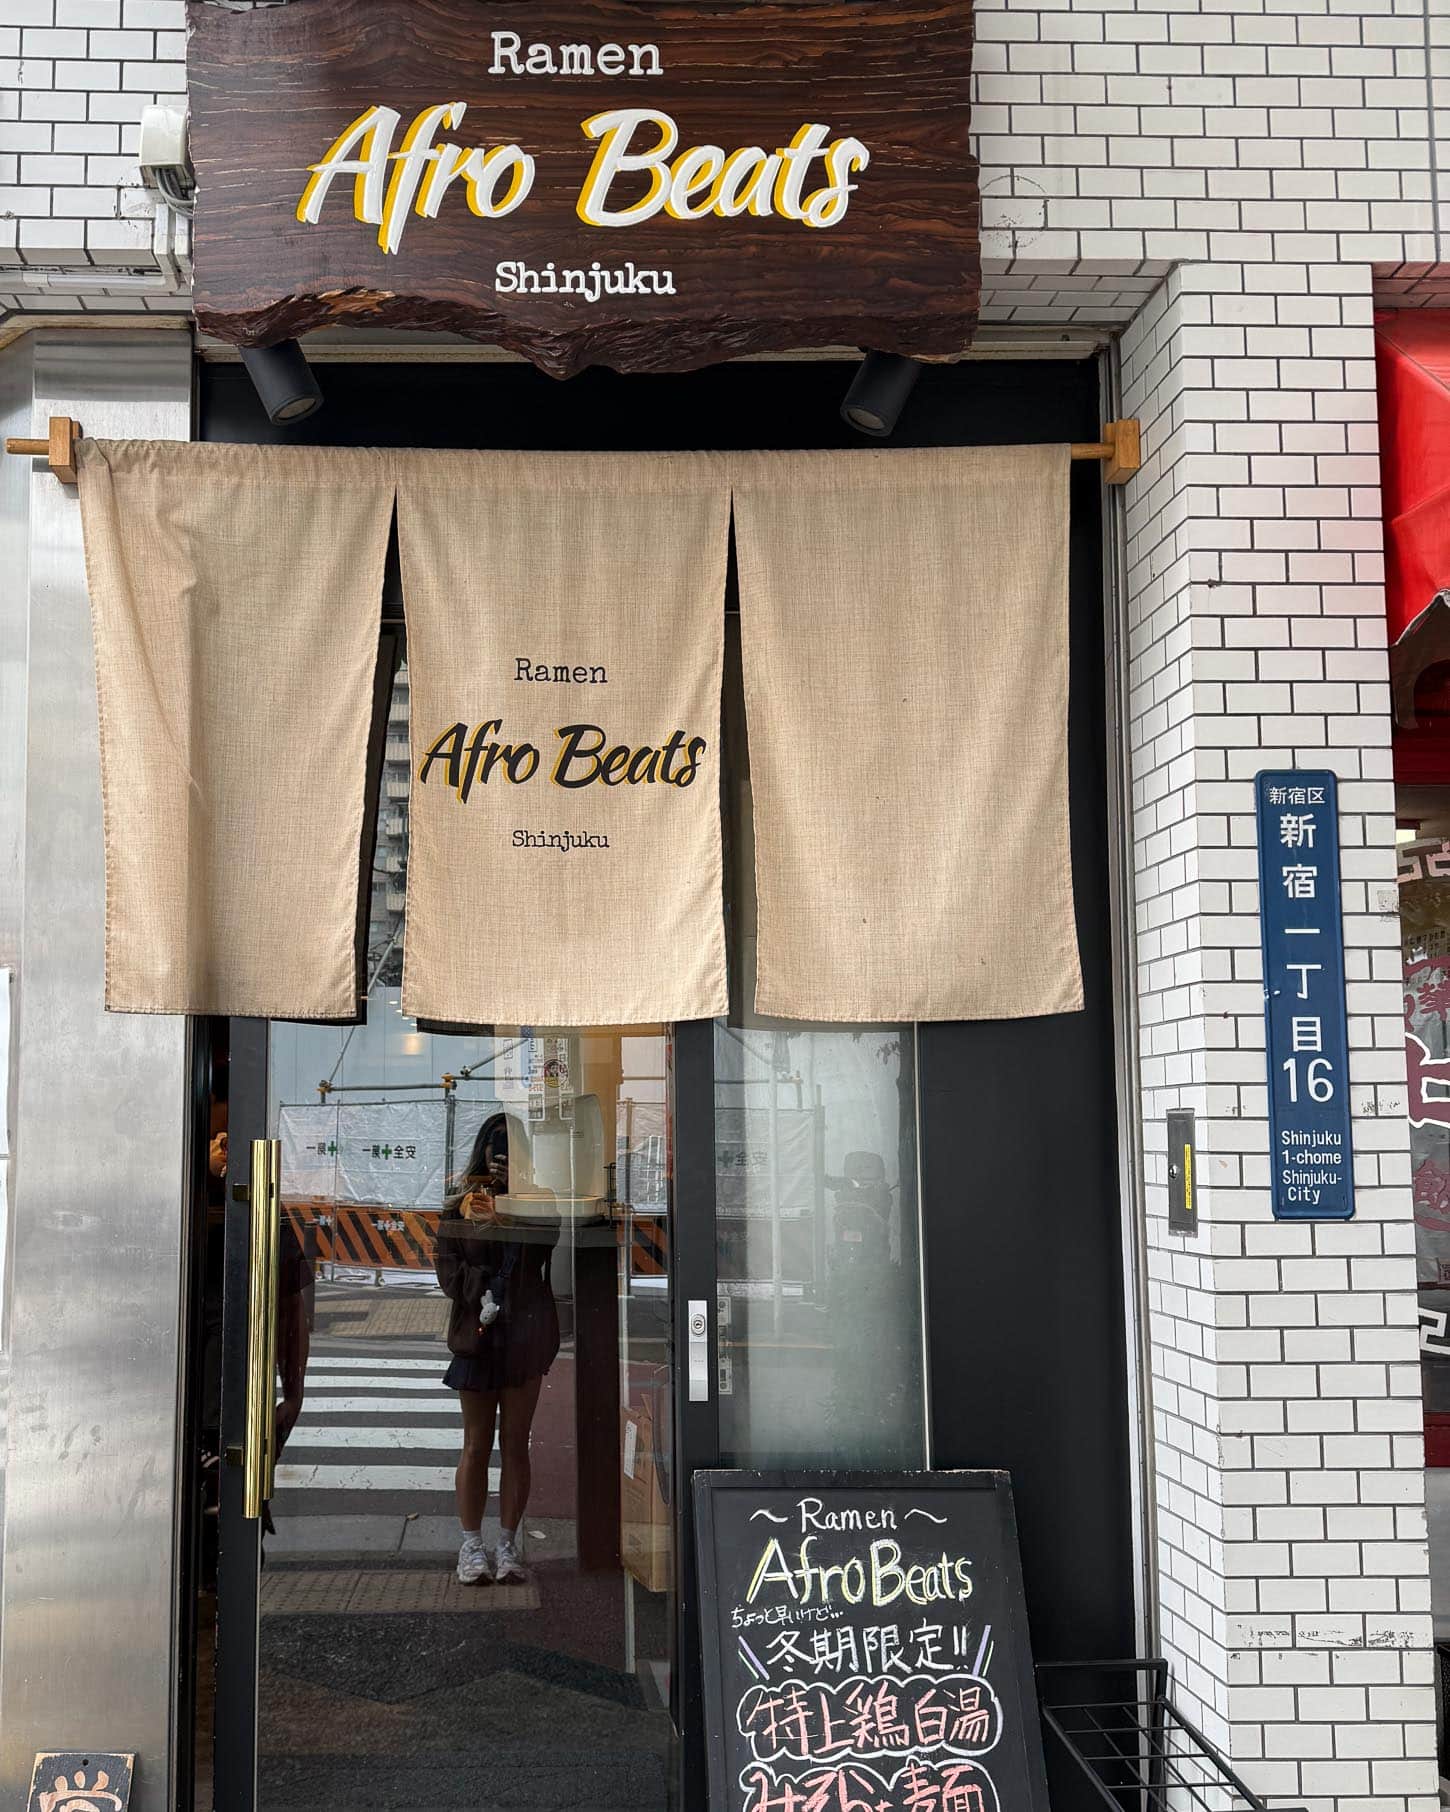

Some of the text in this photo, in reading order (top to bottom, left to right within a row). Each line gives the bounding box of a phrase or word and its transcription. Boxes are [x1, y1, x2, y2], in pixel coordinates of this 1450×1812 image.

[488, 31, 664, 77] Ramen
[297, 101, 870, 256] Afro Beats
[494, 261, 676, 303] Shinjuku
[514, 657, 607, 684] Ramen
[417, 719, 706, 804] Afro Beats
[1269, 787, 1326, 805] 新宿区
[512, 830, 610, 853] Shinjuku
[1279, 812, 1323, 1053] 新宿一丁目
[1283, 1057, 1334, 1103] 16
[1281, 1130, 1342, 1147] Shinjuku
[1282, 1149, 1342, 1165] 1-chome
[1282, 1169, 1342, 1187] Shinjuku-
[1287, 1185, 1321, 1205] City
[797, 1497, 898, 1534] Ramen
[746, 1680, 989, 1756] 特上鶏白湯
